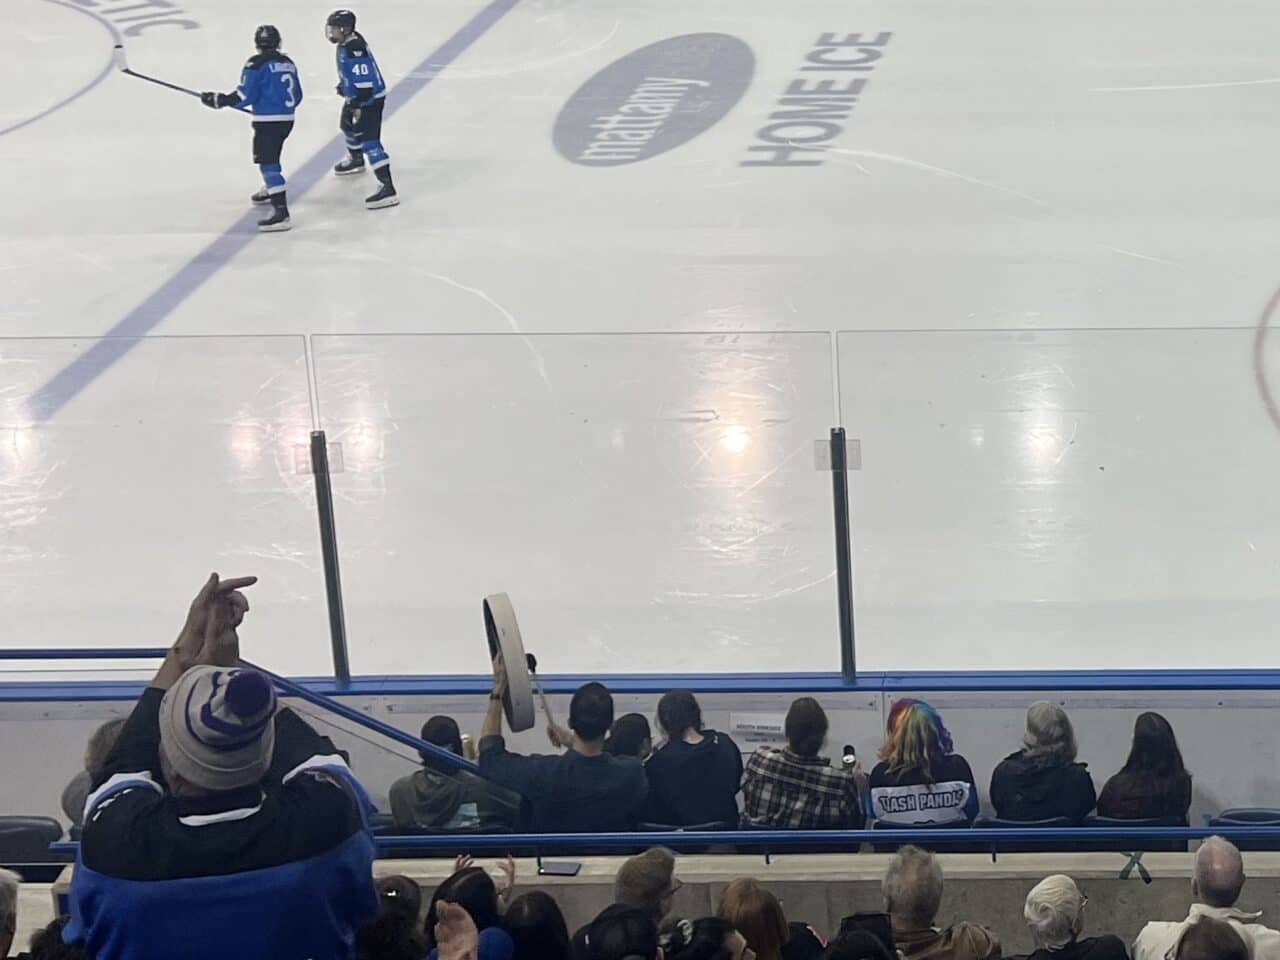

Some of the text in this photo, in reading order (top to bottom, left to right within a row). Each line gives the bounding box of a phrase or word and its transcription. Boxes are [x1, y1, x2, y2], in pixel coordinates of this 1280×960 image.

[352, 63, 369, 76] 40
[281, 72, 296, 108] 3
[738, 31, 893, 168] HOME ICE
